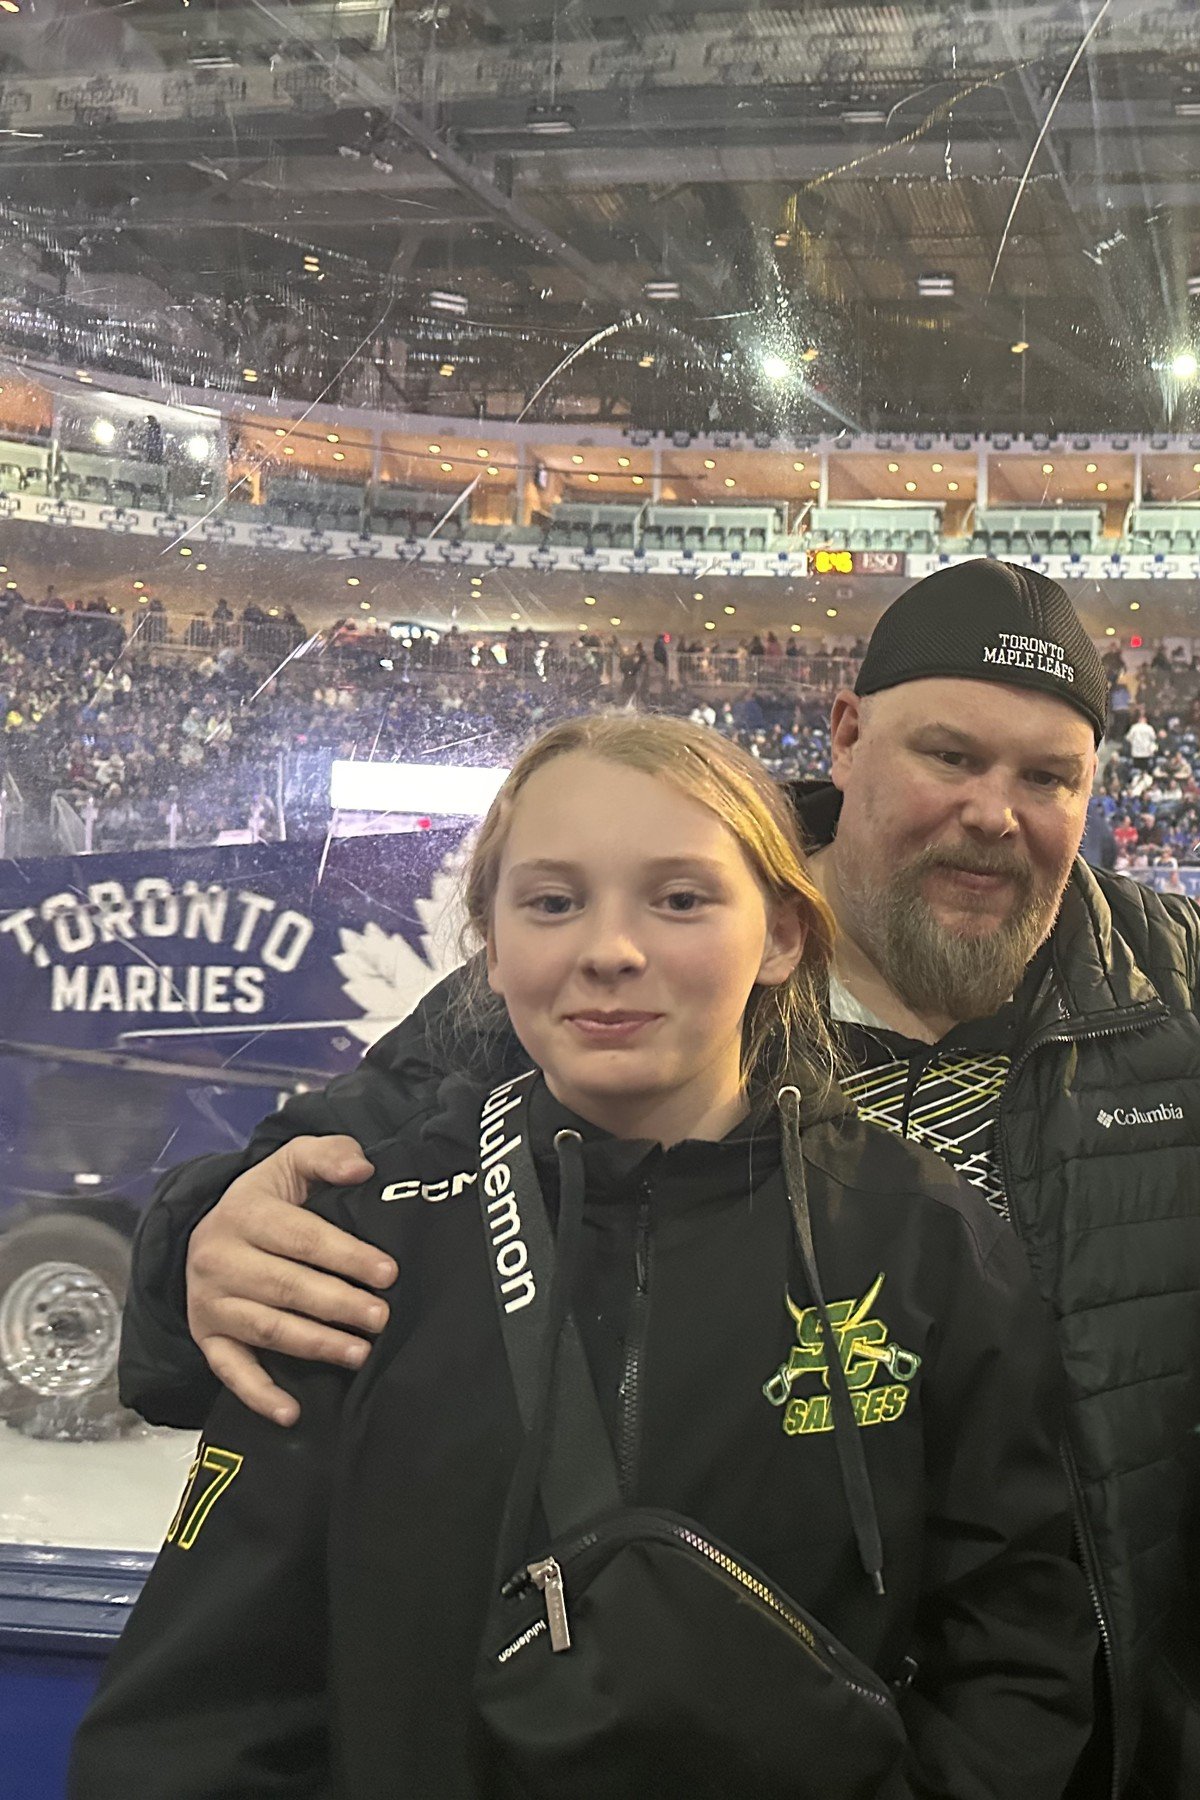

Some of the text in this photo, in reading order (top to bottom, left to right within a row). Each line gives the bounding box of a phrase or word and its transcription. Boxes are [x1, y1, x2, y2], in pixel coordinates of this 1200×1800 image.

[983, 646, 1074, 682] MAPLE LEAFS
[998, 633, 1065, 661] TORONTO
[1, 878, 314, 973] TORONTO
[51, 964, 266, 1013] MARLIES
[1113, 1103, 1184, 1126] Columbia
[498, 1619, 547, 1663] lululemon
